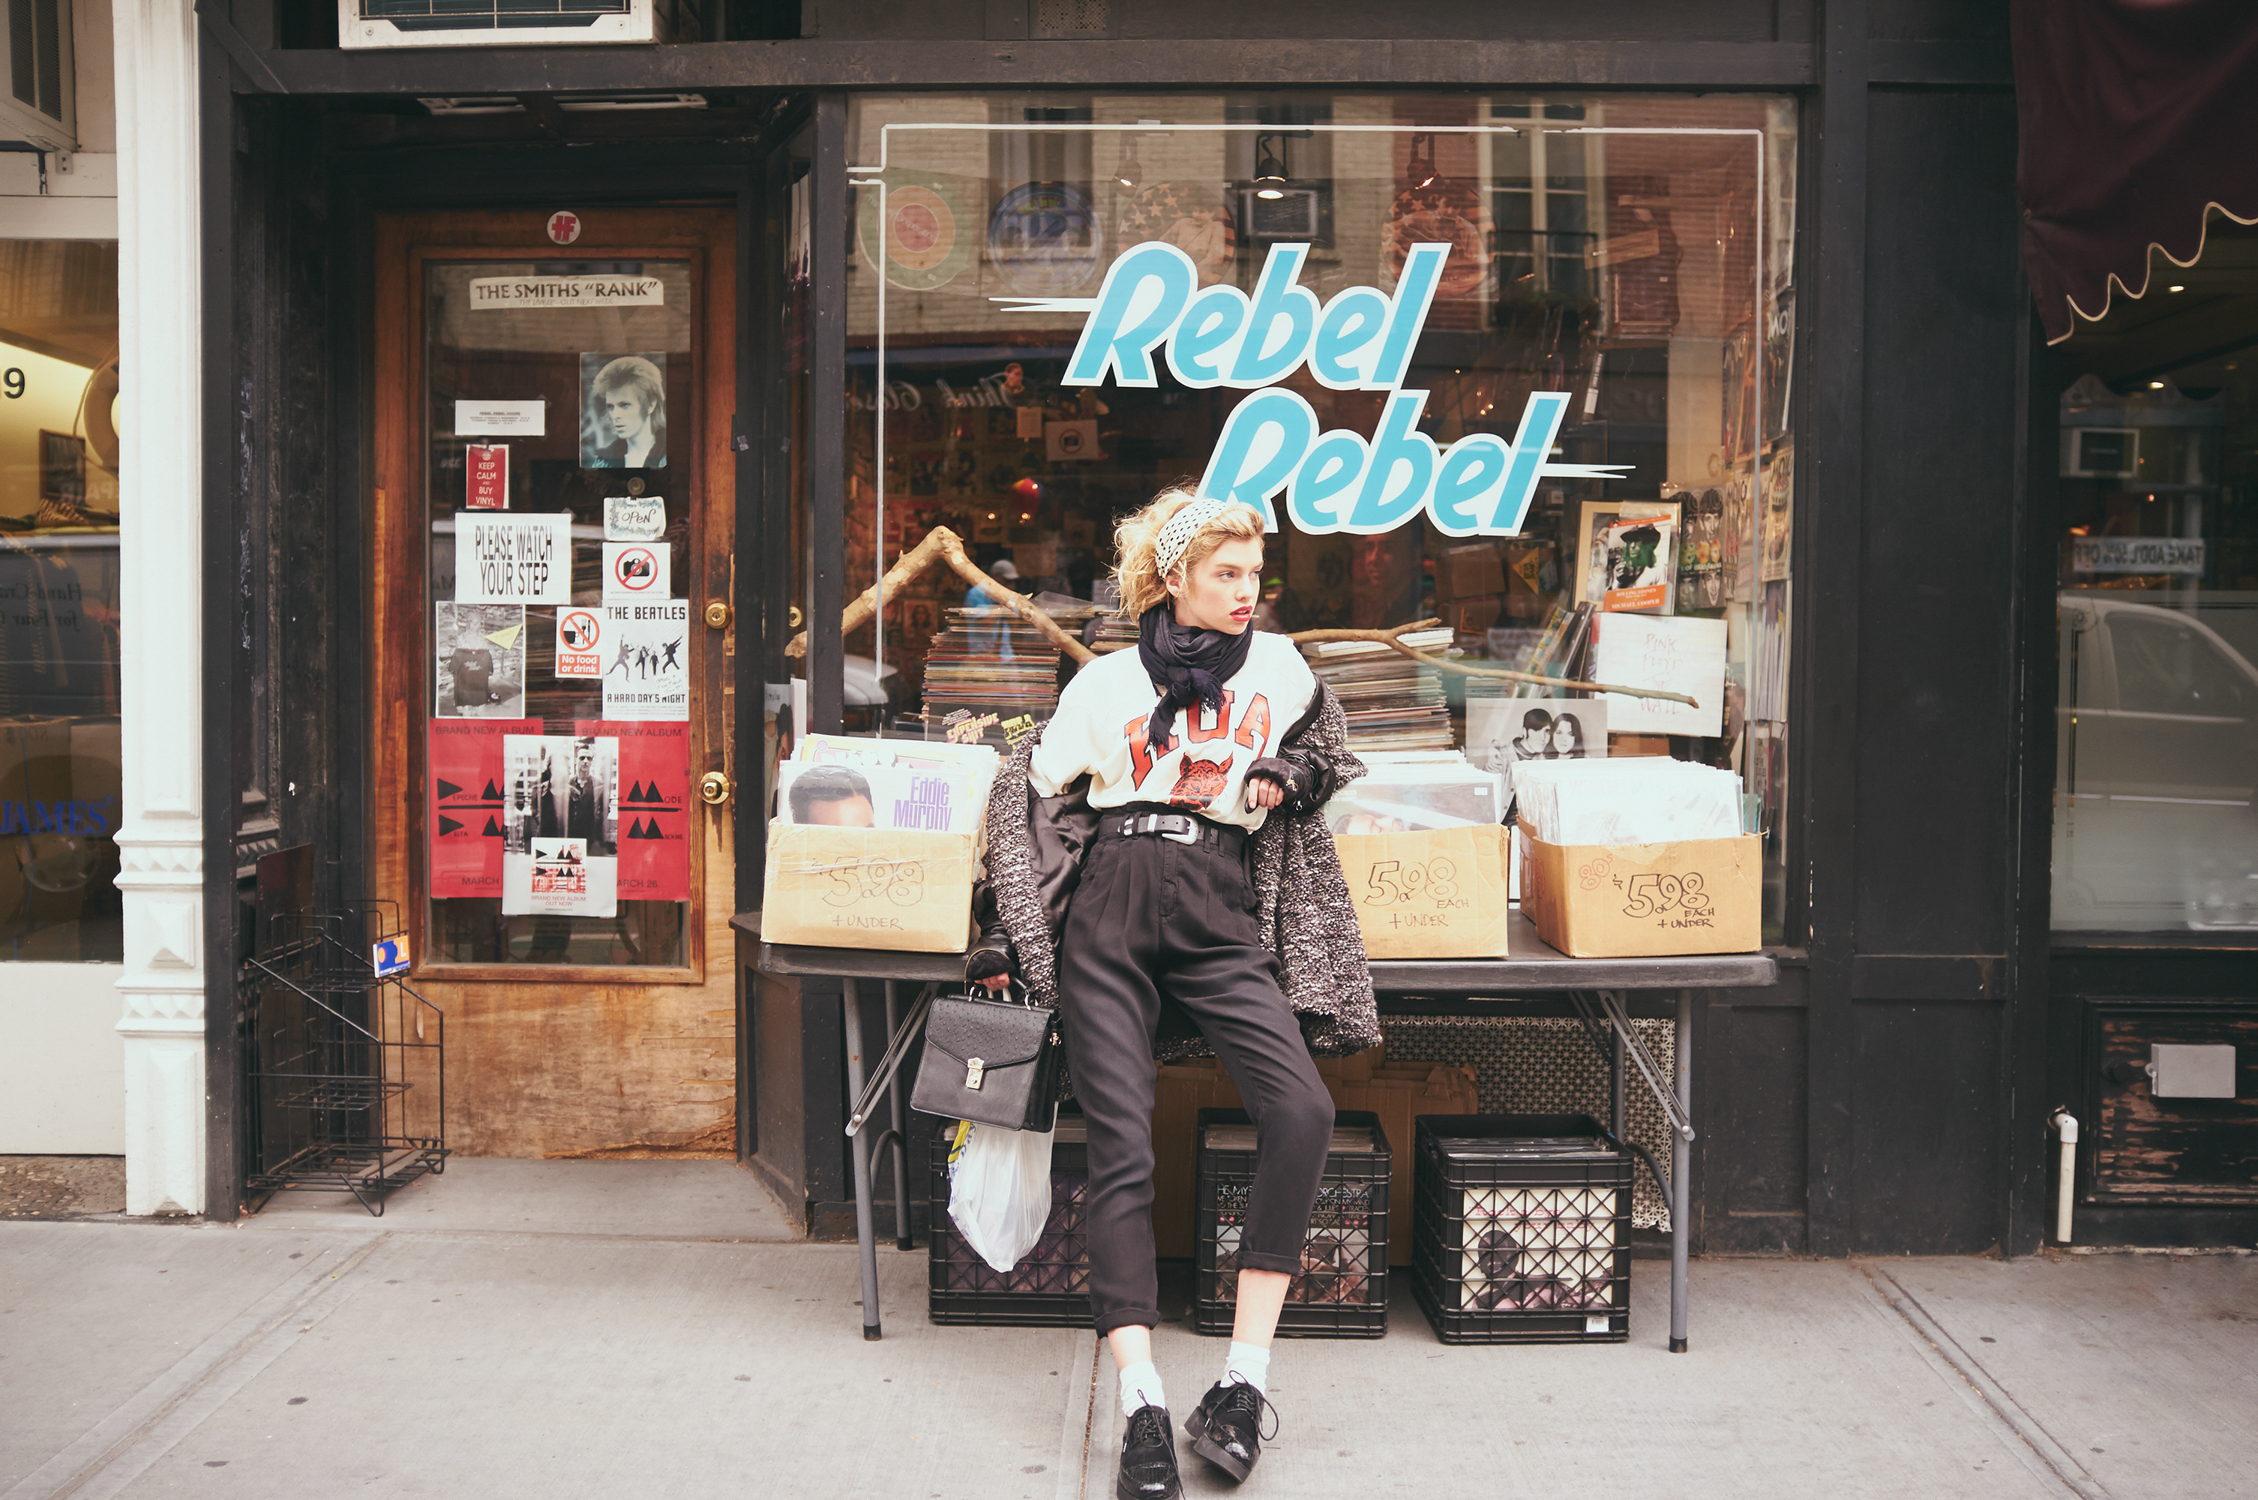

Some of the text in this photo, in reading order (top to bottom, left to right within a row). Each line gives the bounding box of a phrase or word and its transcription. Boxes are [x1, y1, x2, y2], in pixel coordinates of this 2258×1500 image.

[476, 285, 509, 299] THE
[514, 283, 579, 298] SMITHS
[1061, 241, 1452, 390] Rebel
[478, 462, 495, 470] KEEP
[1196, 387, 1571, 537] Rebel
[476, 472, 497, 480] CALM
[478, 487, 493, 495] BUY
[475, 496, 496, 506] VINYL
[475, 525, 553, 561] PLEASE WATCH
[480, 561, 514, 596] YOUR
[517, 562, 549, 596] STEP
[607, 606, 686, 620] THE BEATLES
[1643, 633, 1678, 654] PINK
[561, 655, 597, 664] No food
[1643, 650, 1683, 672] FLOYD
[561, 664, 597, 673] or drink
[607, 693, 686, 703] A HARD DAY'S NIGHT
[1640, 697, 1681, 715] WALL
[435, 726, 535, 735] BRAND NEW ALBUM
[581, 728, 682, 737] BRAND NEW ALBUM
[961, 727, 984, 745] SHIT
[909, 776, 950, 806] Eddie
[893, 799, 952, 832] Murphy
[461, 877, 499, 885] MARCH
[617, 879, 658, 888] ARCH 26
[1436, 898, 1469, 909] EACH
[1684, 907, 1715, 918] EACH
